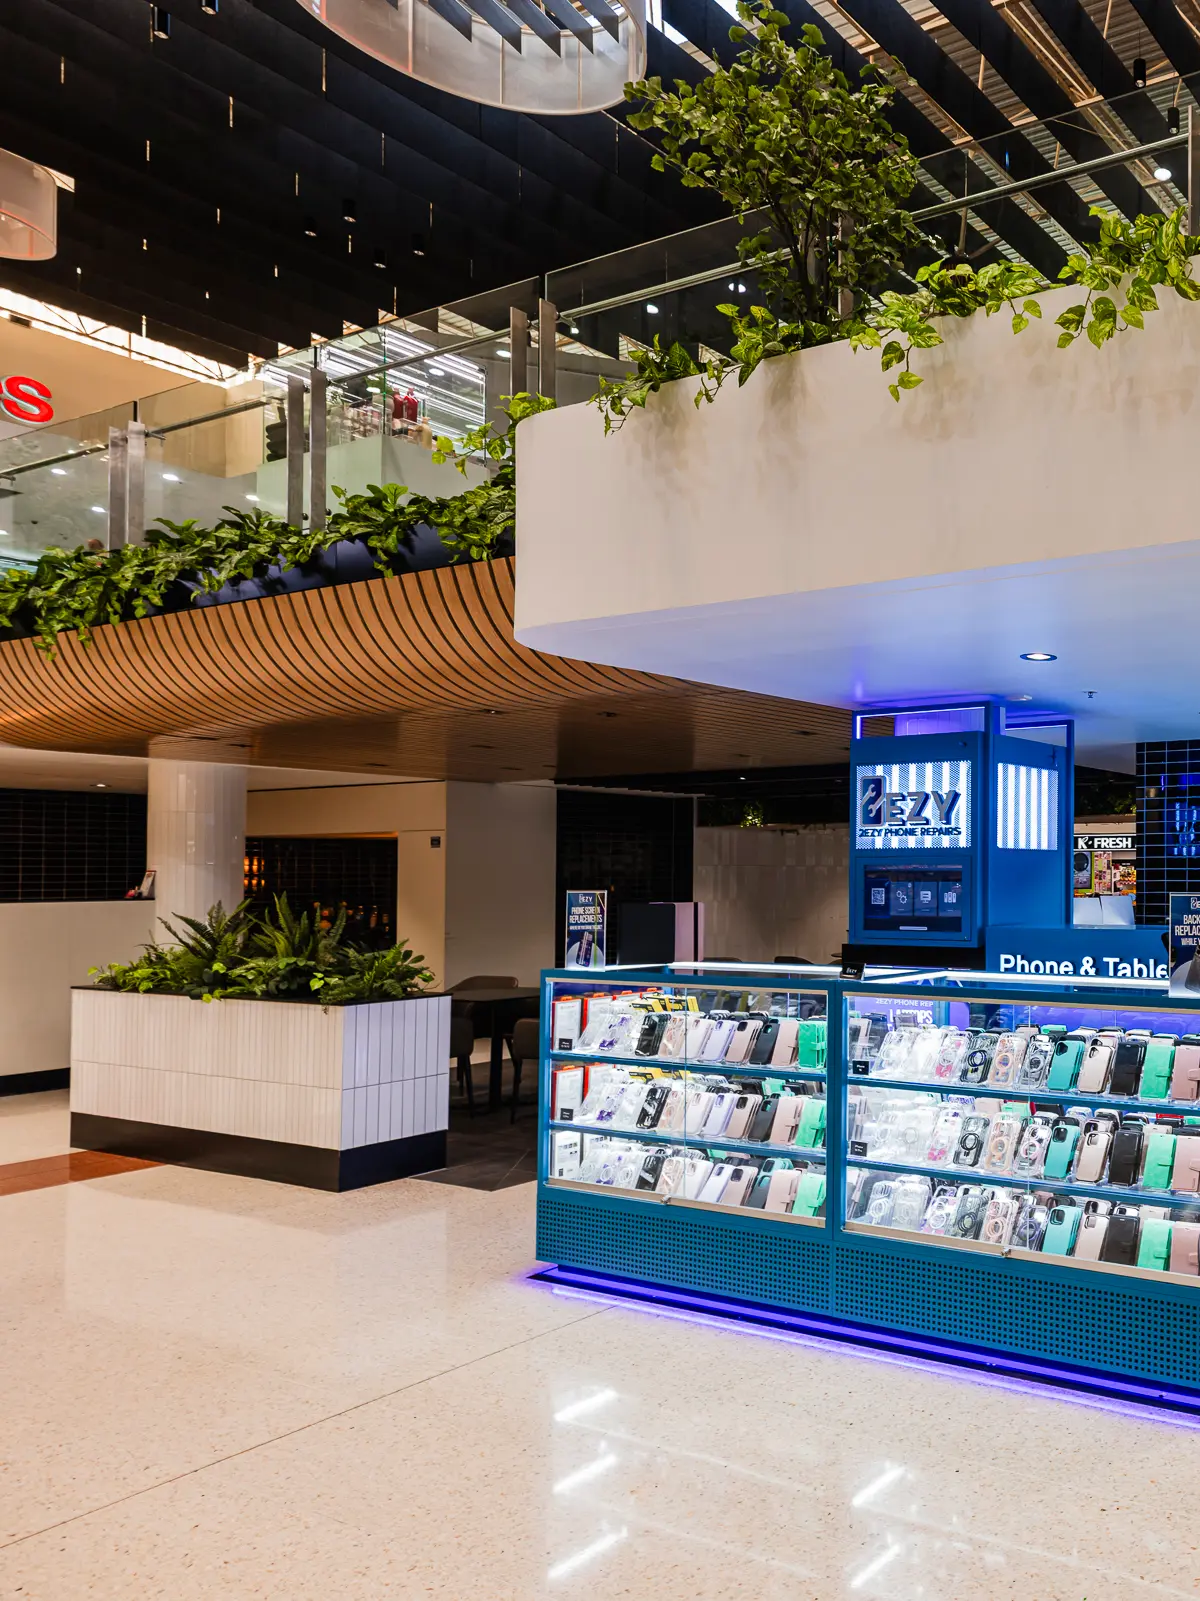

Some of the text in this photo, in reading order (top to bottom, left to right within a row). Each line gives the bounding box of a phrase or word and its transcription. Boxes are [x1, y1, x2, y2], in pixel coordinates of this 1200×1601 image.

[859, 827, 961, 838] 2EZY PHONE REPAIRS
[571, 907, 585, 915] PHONE
[569, 914, 602, 923] REPLACEMENTS
[1181, 938, 1197, 946] WHILE
[1000, 954, 1073, 974] Phone
[1080, 956, 1096, 976] &
[1103, 957, 1169, 978] Table
[894, 999, 918, 1007] PHONE
